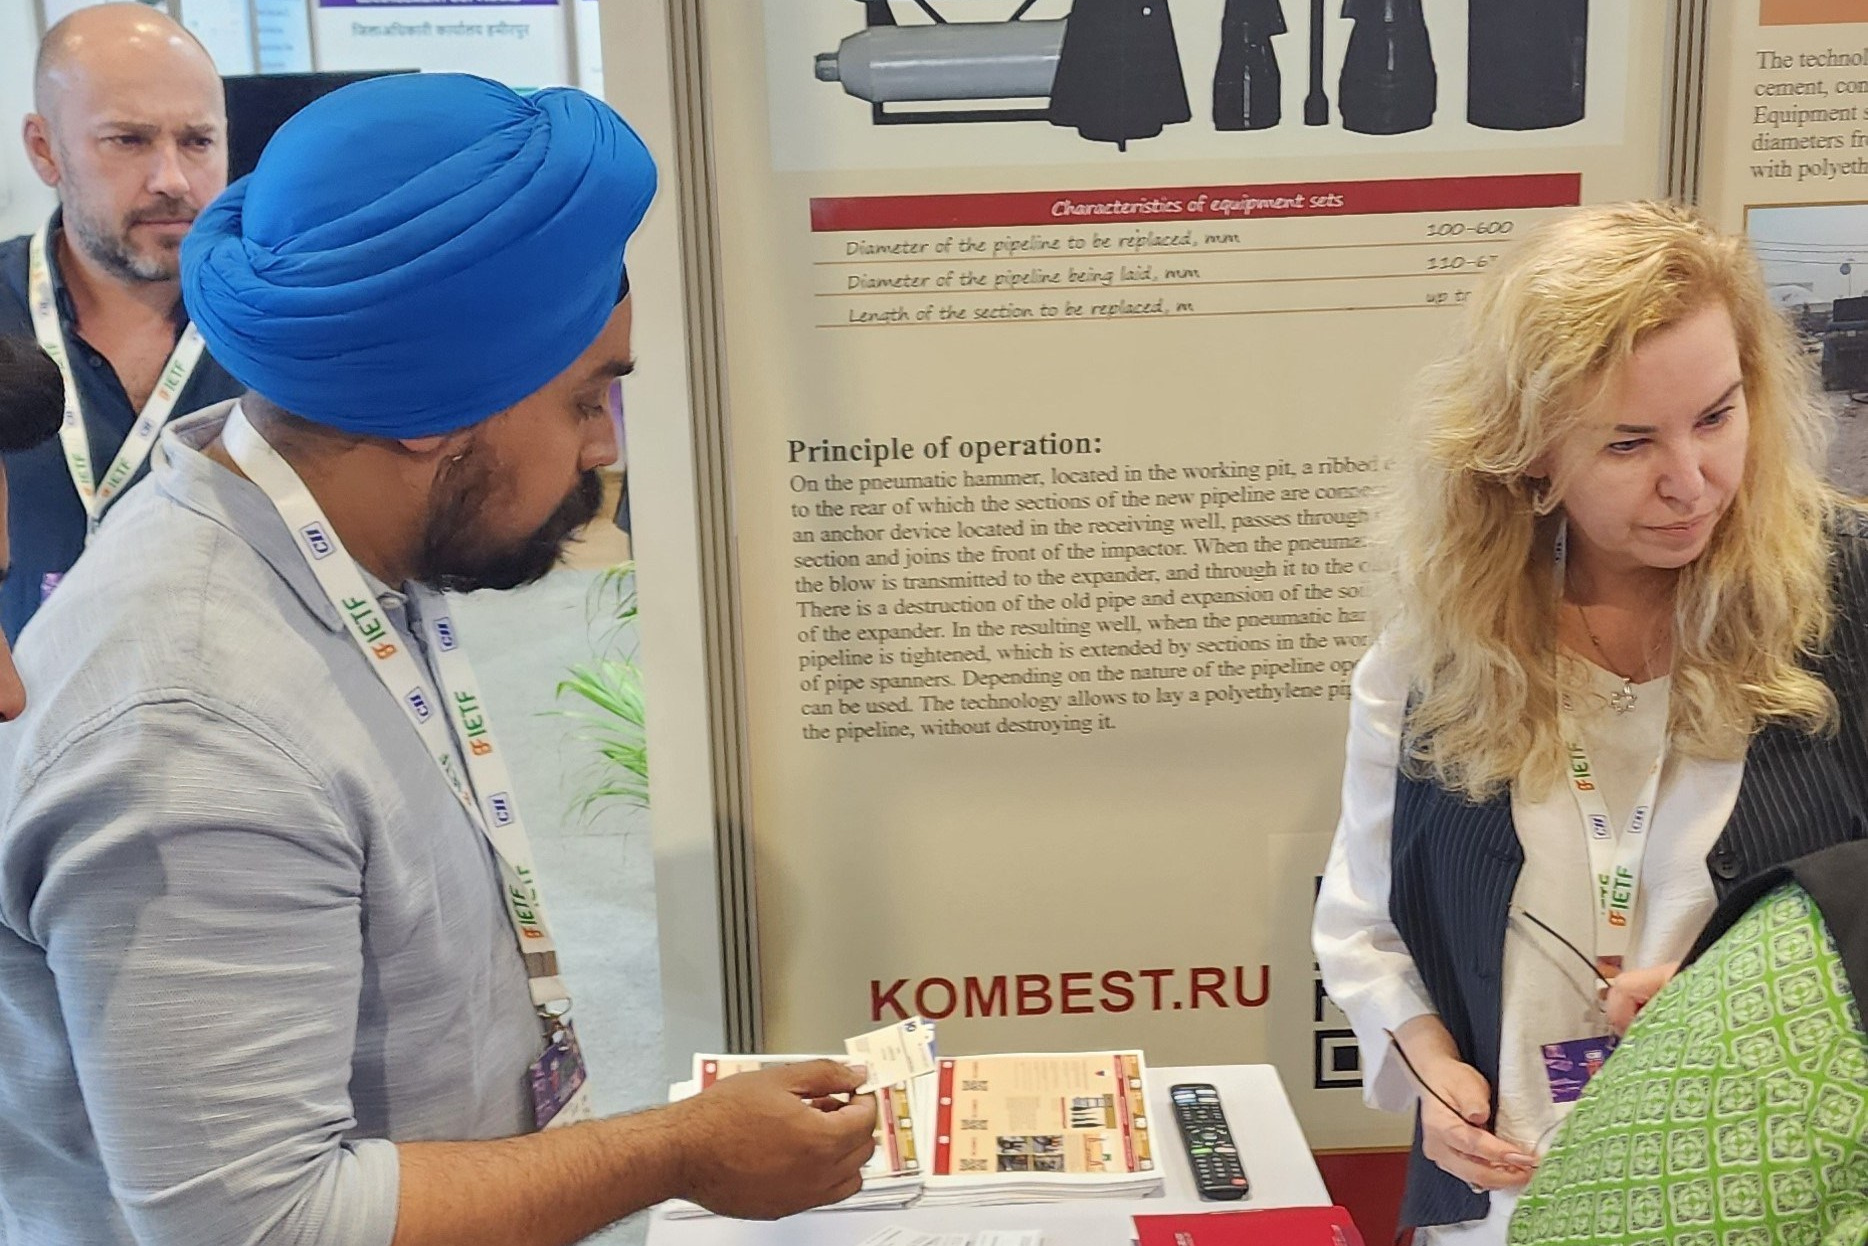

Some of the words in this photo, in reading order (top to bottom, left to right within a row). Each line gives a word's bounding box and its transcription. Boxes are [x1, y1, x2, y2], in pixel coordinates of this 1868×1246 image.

[1756, 51, 1793, 69] The
[1755, 81, 1828, 98] cement,
[1752, 104, 1857, 128] Equipment
[1751, 132, 1844, 151] diameters
[1749, 159, 1792, 177] with
[1051, 197, 1182, 216] Characteristics
[1187, 194, 1208, 213] of
[1210, 193, 1305, 216] equipment
[1309, 193, 1344, 208] sets
[846, 240, 929, 256] Diameter
[935, 236, 953, 253] of
[958, 237, 986, 252] the
[992, 235, 1060, 257] pipeline
[1067, 235, 1086, 249] to
[1092, 231, 1111, 248] be
[1118, 229, 1198, 251] replaced,
[1204, 233, 1241, 244] mm
[1426, 221, 1515, 237] 100-600
[847, 274, 930, 290] Diameter
[935, 270, 954, 287] of
[959, 271, 987, 286] the
[993, 268, 1061, 290] pipeline
[1068, 266, 1114, 286] being
[1120, 265, 1158, 281] laid,
[1165, 268, 1200, 279] mm
[849, 305, 910, 323] Length
[916, 304, 934, 321] of
[939, 304, 967, 320] the
[973, 302, 1034, 320] section
[1040, 302, 1058, 317] to
[1065, 300, 1083, 316] be
[1091, 298, 1169, 318] replaced,
[786, 437, 914, 468] Principle
[923, 435, 953, 460] of
[959, 432, 1101, 465] operation:
[790, 474, 819, 493] On
[824, 473, 854, 492] the
[858, 470, 958, 496] pneumatic
[962, 469, 1045, 491] hammer,
[1051, 464, 1119, 488] located
[1147, 463, 1177, 481] the
[1182, 462, 1260, 484] working
[1265, 459, 1297, 481] pit,
[815, 499, 845, 517] the
[849, 503, 888, 517] rear
[917, 495, 975, 514] which
[980, 494, 1010, 512] the
[1015, 492, 1091, 516] sections
[1095, 490, 1119, 509] of
[1121, 489, 1151, 508] the
[1155, 492, 1195, 512] new
[1200, 485, 1276, 509] pipeline
[1280, 488, 1310, 501] are
[305, 529, 329, 553] CII
[820, 524, 886, 543] anchor
[889, 521, 951, 541] device
[957, 519, 1025, 543] located
[1053, 517, 1083, 535] the
[1087, 513, 1175, 539] receiving
[1180, 511, 1226, 536] well,
[1231, 513, 1292, 534] passes
[794, 550, 860, 569] section
[865, 548, 900, 566] and
[902, 547, 951, 570] joins
[956, 545, 985, 568] the
[991, 544, 1036, 563] front
[1066, 542, 1096, 565] the
[1101, 540, 1187, 563] impactor.
[1192, 537, 1249, 560] When
[1253, 535, 1283, 558] the
[795, 576, 824, 594] the
[828, 574, 876, 593] blow
[902, 569, 1007, 590] transmitted
[1037, 568, 1066, 591] the
[1071, 565, 1161, 589] expander,
[1165, 563, 1200, 581] and
[1205, 559, 1278, 582] through
[1324, 557, 1354, 575] the
[795, 600, 851, 618] There
[893, 595, 997, 615] destruction
[1027, 593, 1056, 615] the
[1060, 591, 1091, 610] old
[1095, 590, 1137, 614] pipe
[1141, 588, 1176, 606] and
[1180, 585, 1274, 609] expansion
[1278, 583, 1303, 607] of
[1304, 583, 1333, 600] the
[342, 597, 387, 643] IETF
[822, 625, 852, 642] the
[856, 622, 945, 645] expander.
[976, 620, 1005, 637] the
[1010, 616, 1091, 638] resulting
[1095, 615, 1142, 632] well,
[1147, 613, 1198, 631] when
[1202, 612, 1232, 629] the
[1236, 607, 1333, 633] pneumatic
[798, 648, 874, 672] pipeline
[900, 644, 992, 668] tightened,
[996, 642, 1053, 660] which
[1079, 638, 1163, 662] extended
[1167, 638, 1191, 658] by
[1196, 635, 1271, 654] sections
[1299, 632, 1328, 653] the
[1332, 634, 1368, 647] wor
[824, 673, 865, 696] pipe
[870, 675, 956, 694] spanners.
[962, 666, 1064, 691] Depending
[1067, 670, 1091, 683] on
[1096, 664, 1125, 682] the
[1130, 666, 1188, 683] nature
[1192, 660, 1215, 678] of
[1217, 660, 1246, 677] the
[1250, 657, 1325, 681] pipeline
[453, 691, 488, 738] IETF
[801, 703, 833, 716] can
[838, 698, 861, 715] be
[866, 696, 913, 714] used.
[918, 695, 955, 712] The
[960, 692, 1062, 713] technology
[1067, 689, 1127, 707] allows
[1132, 691, 1151, 705] to
[1156, 686, 1183, 707] lay
[1188, 690, 1200, 702] a
[1204, 682, 1324, 707] polyethylene
[802, 723, 831, 740] the
[835, 720, 915, 744] pipeline,
[920, 718, 992, 736] without
[995, 714, 1093, 739] destroying
[1098, 713, 1116, 730] it.
[1610, 865, 1634, 910] IETF
[509, 884, 538, 925] IETF
[870, 964, 1270, 1021] KOMBEST.RU
